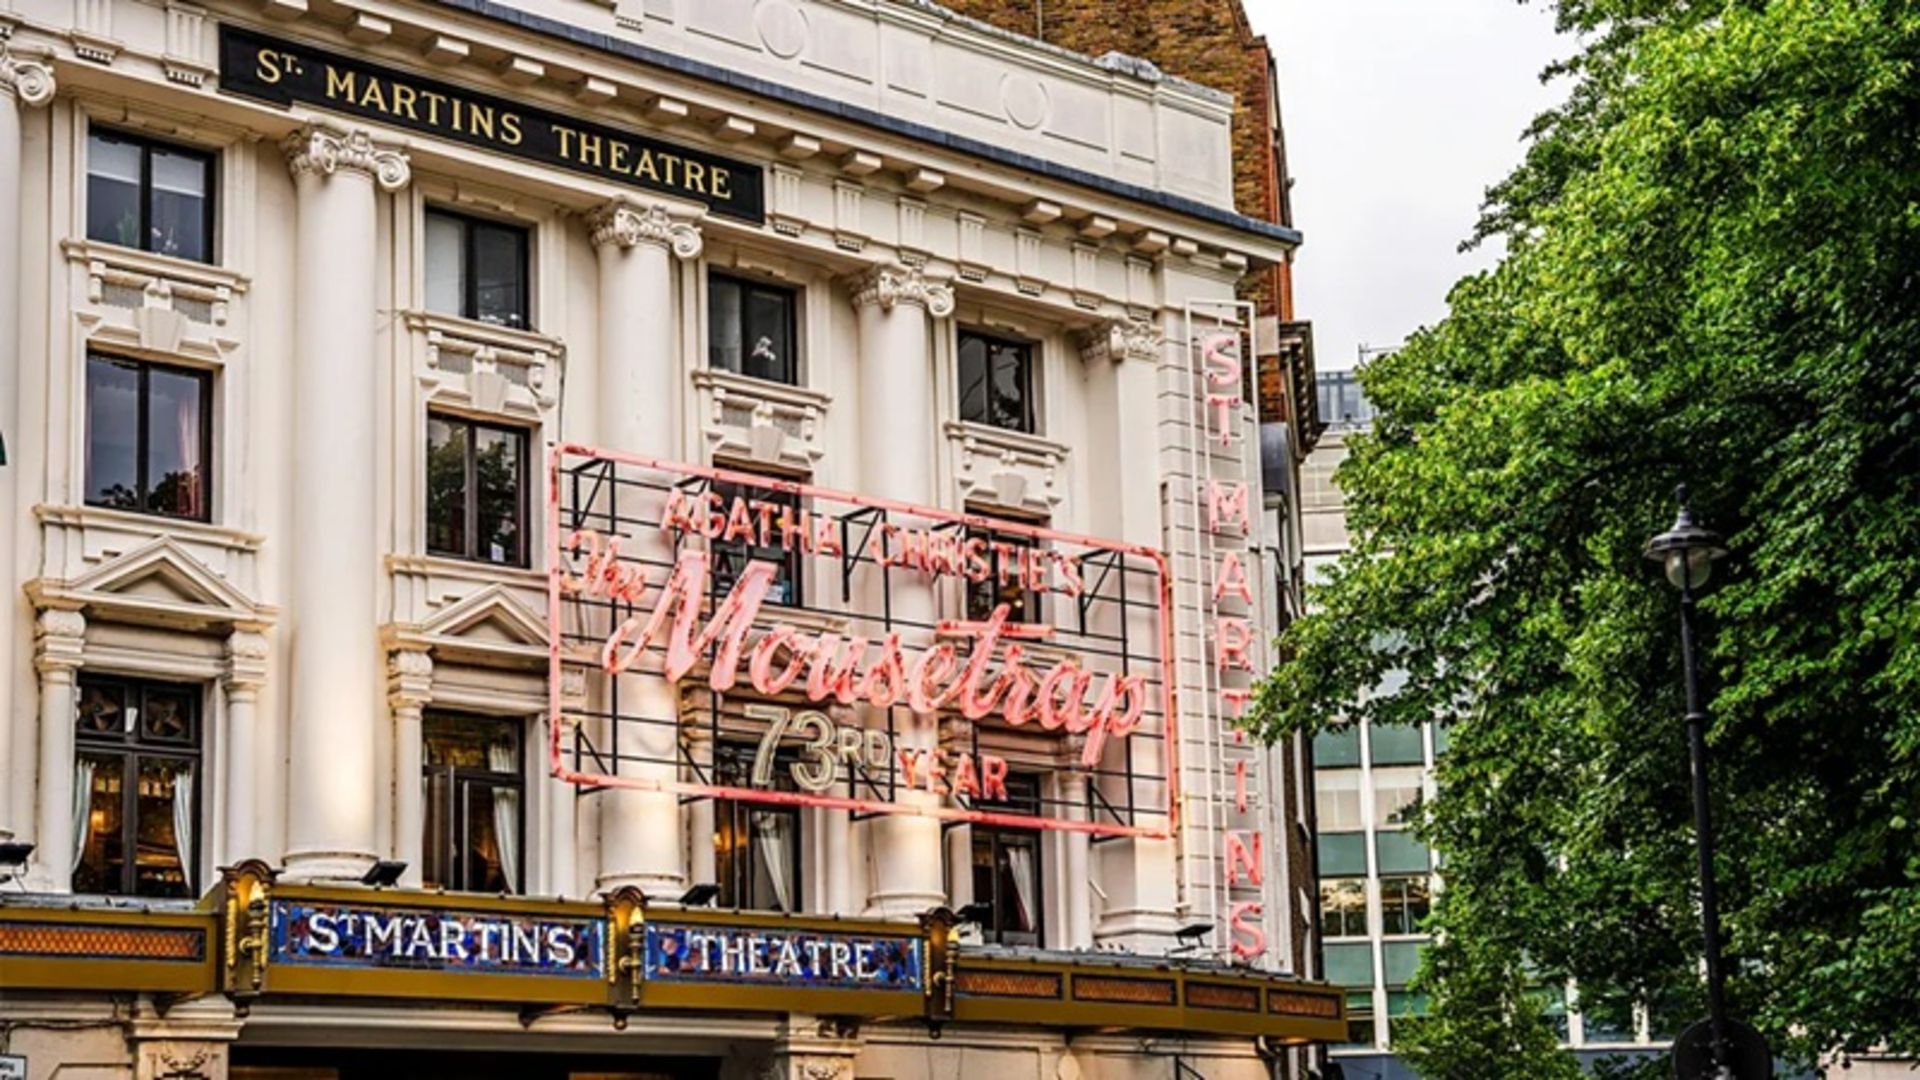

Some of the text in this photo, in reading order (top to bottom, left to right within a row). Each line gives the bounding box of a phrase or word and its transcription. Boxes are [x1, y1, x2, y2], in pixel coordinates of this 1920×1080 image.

[325, 65, 523, 145] MARTINS
[552, 125, 731, 198] THEATRE
[659, 487, 843, 558] AGATHA
[602, 549, 1147, 767] Mousetrap
[1204, 334, 1266, 962] ST MARTINS
[744, 703, 1009, 802] 73RD YEAR
[692, 935, 879, 979] THEATRE
